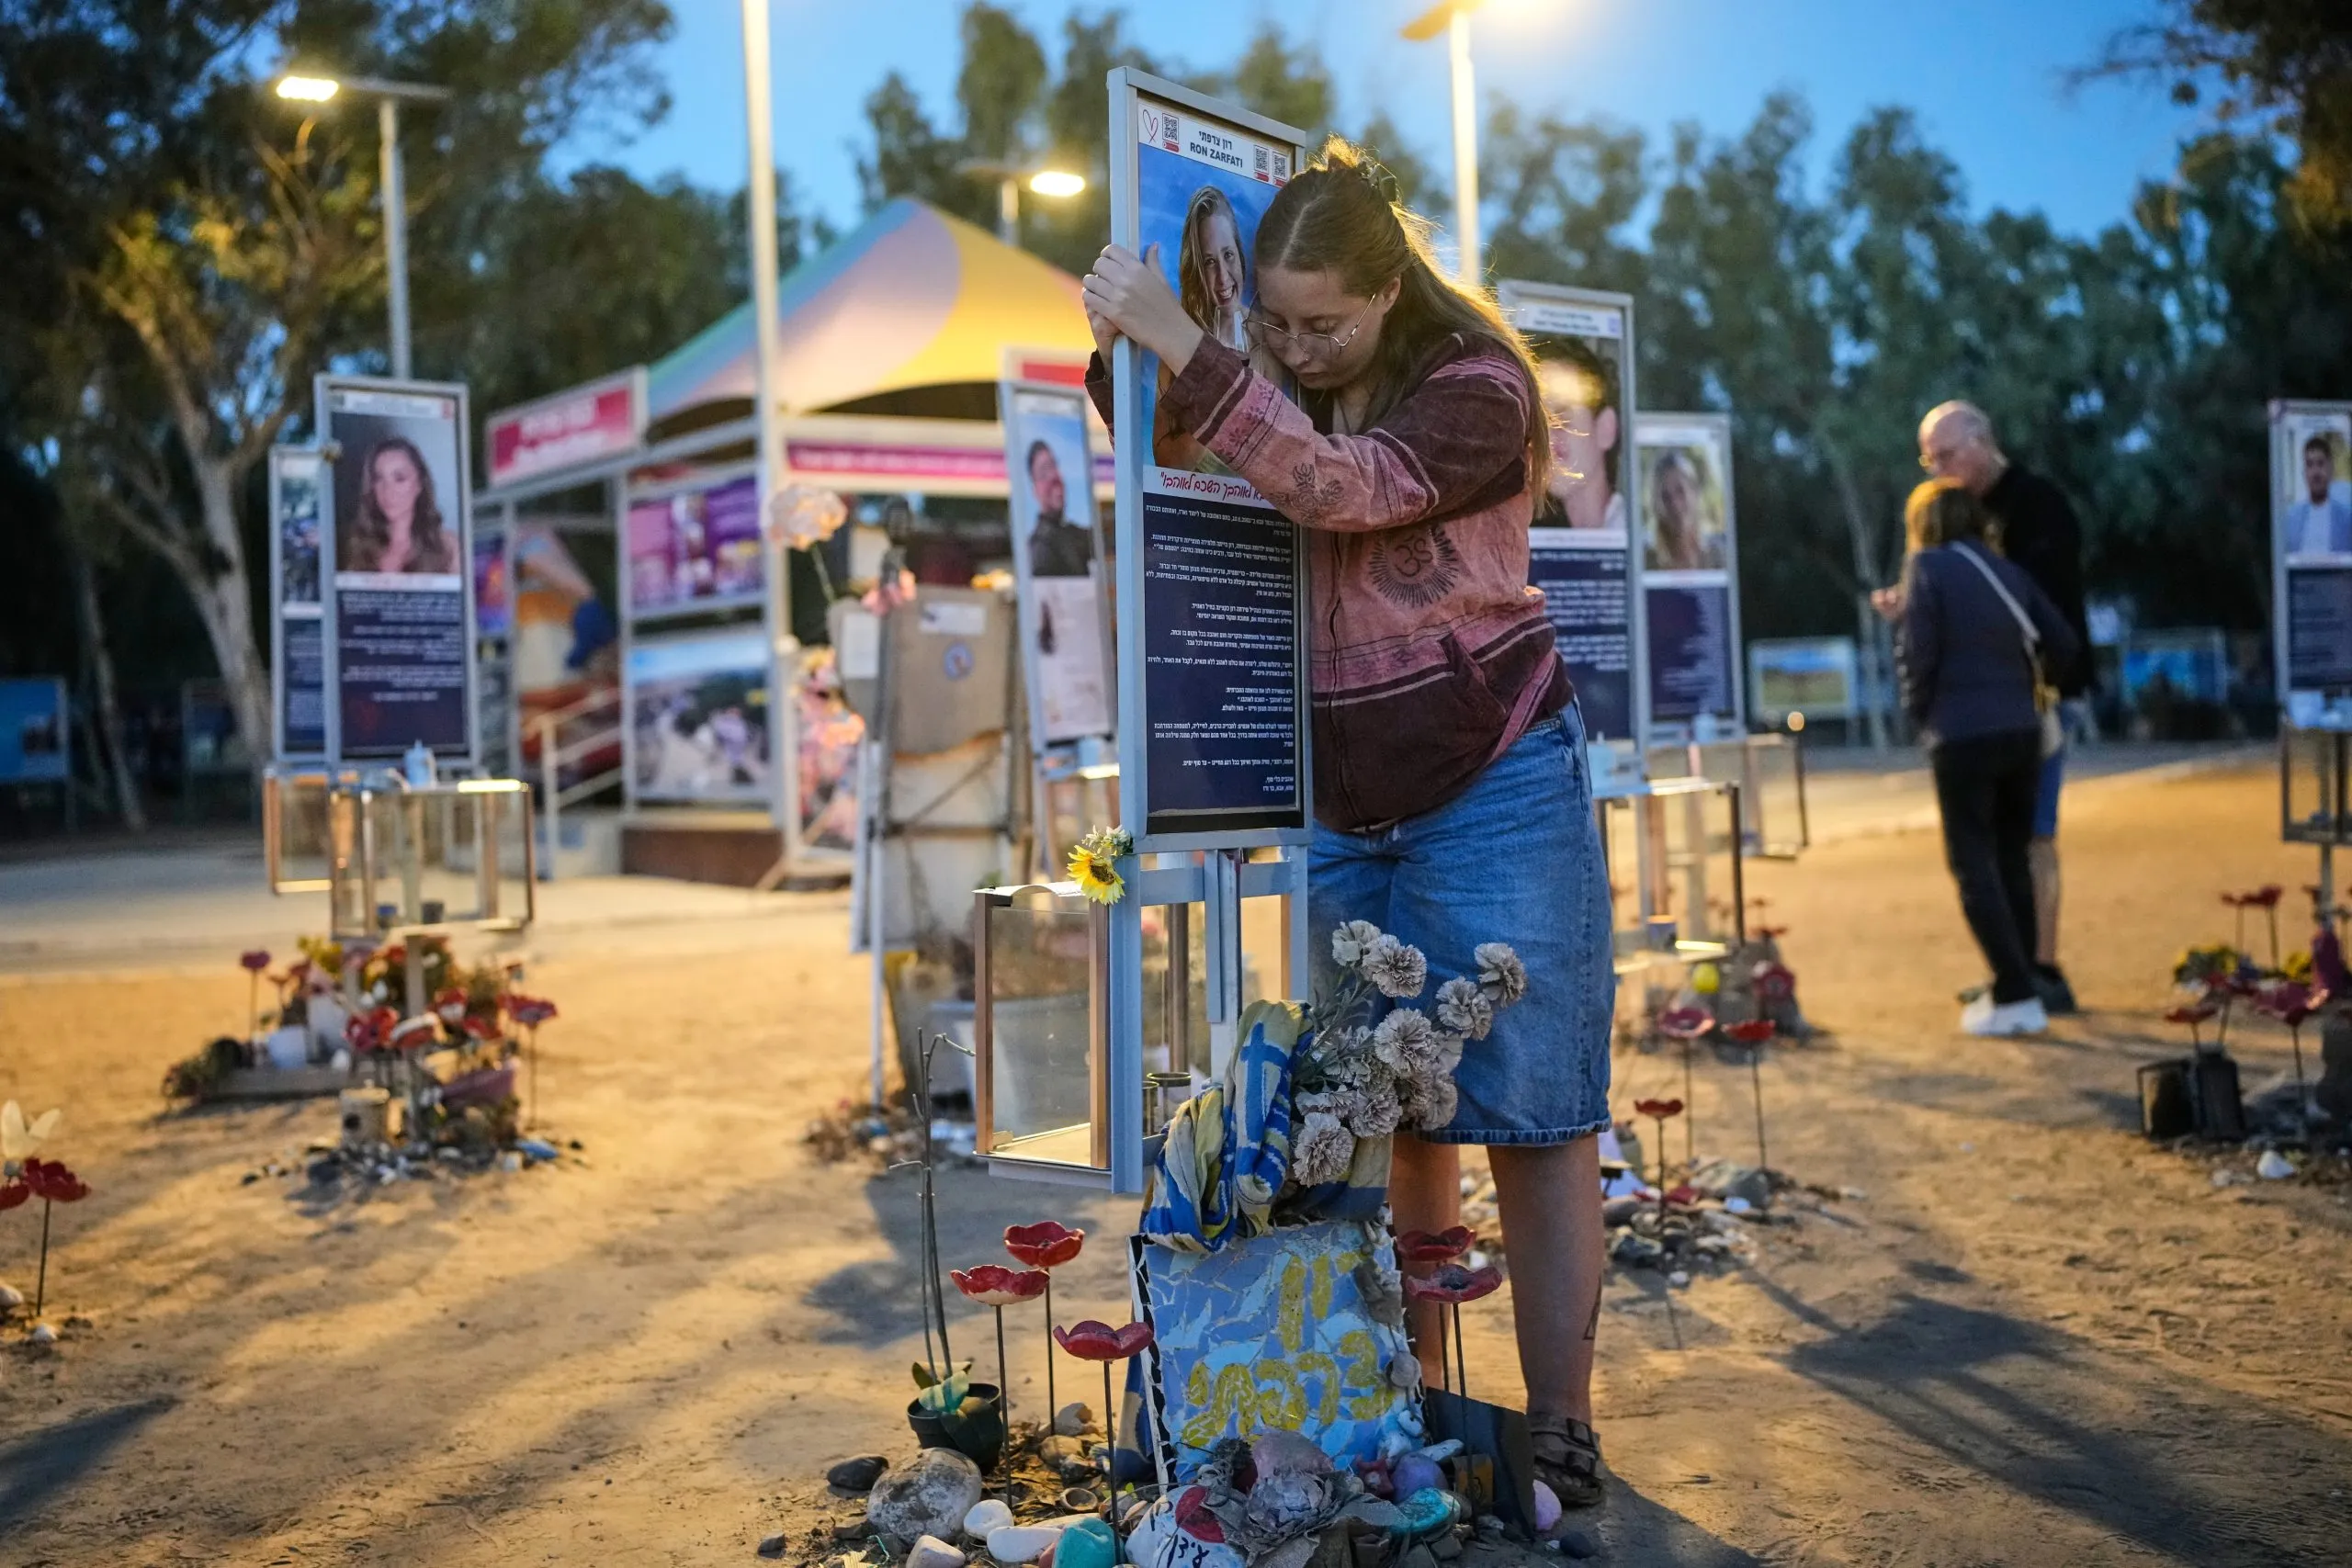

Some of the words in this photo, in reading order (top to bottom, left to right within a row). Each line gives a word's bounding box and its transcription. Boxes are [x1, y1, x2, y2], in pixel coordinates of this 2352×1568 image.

[1199, 130, 1221, 145] צרפתי
[1222, 139, 1232, 150] רון
[1190, 141, 1207, 156] RON
[1209, 148, 1243, 168] ZARFATI
[1193, 479, 1220, 493] השכם
[1278, 1251, 1363, 1351] ון
